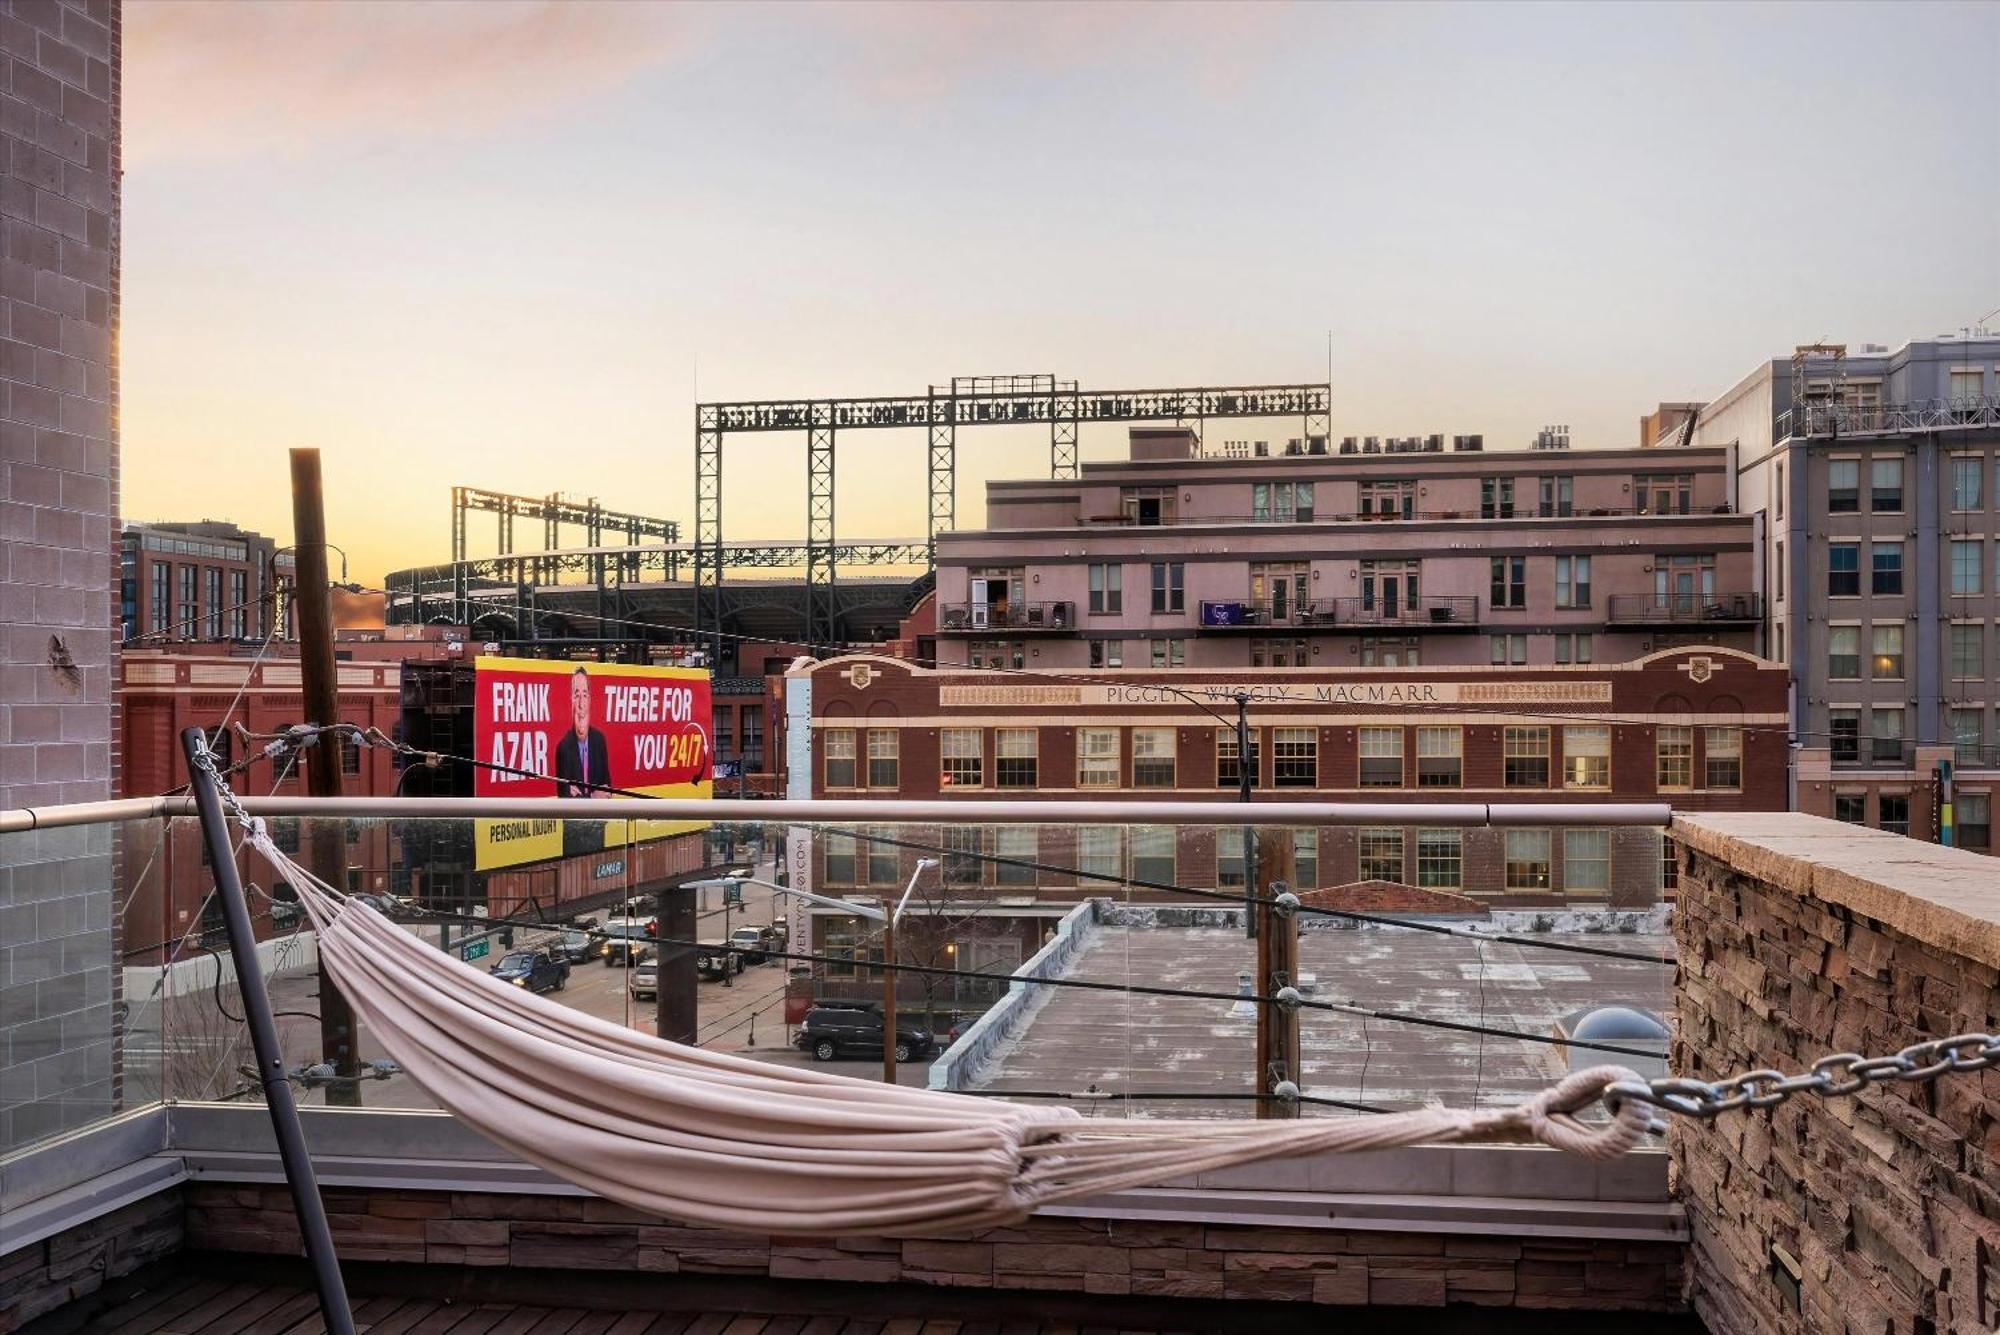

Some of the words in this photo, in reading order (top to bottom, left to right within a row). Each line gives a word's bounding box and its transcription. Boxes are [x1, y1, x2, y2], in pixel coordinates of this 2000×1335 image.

[493, 682, 550, 722] FRANK
[605, 685, 658, 722] THERE
[661, 687, 692, 722] FOR
[1107, 686, 1182, 702] PIGGLY
[1316, 685, 1438, 701] MACMARR
[490, 731, 548, 783] AZAR
[634, 734, 666, 770] YOU
[668, 734, 702, 768] 24/7
[490, 821, 531, 843] PERSONAL
